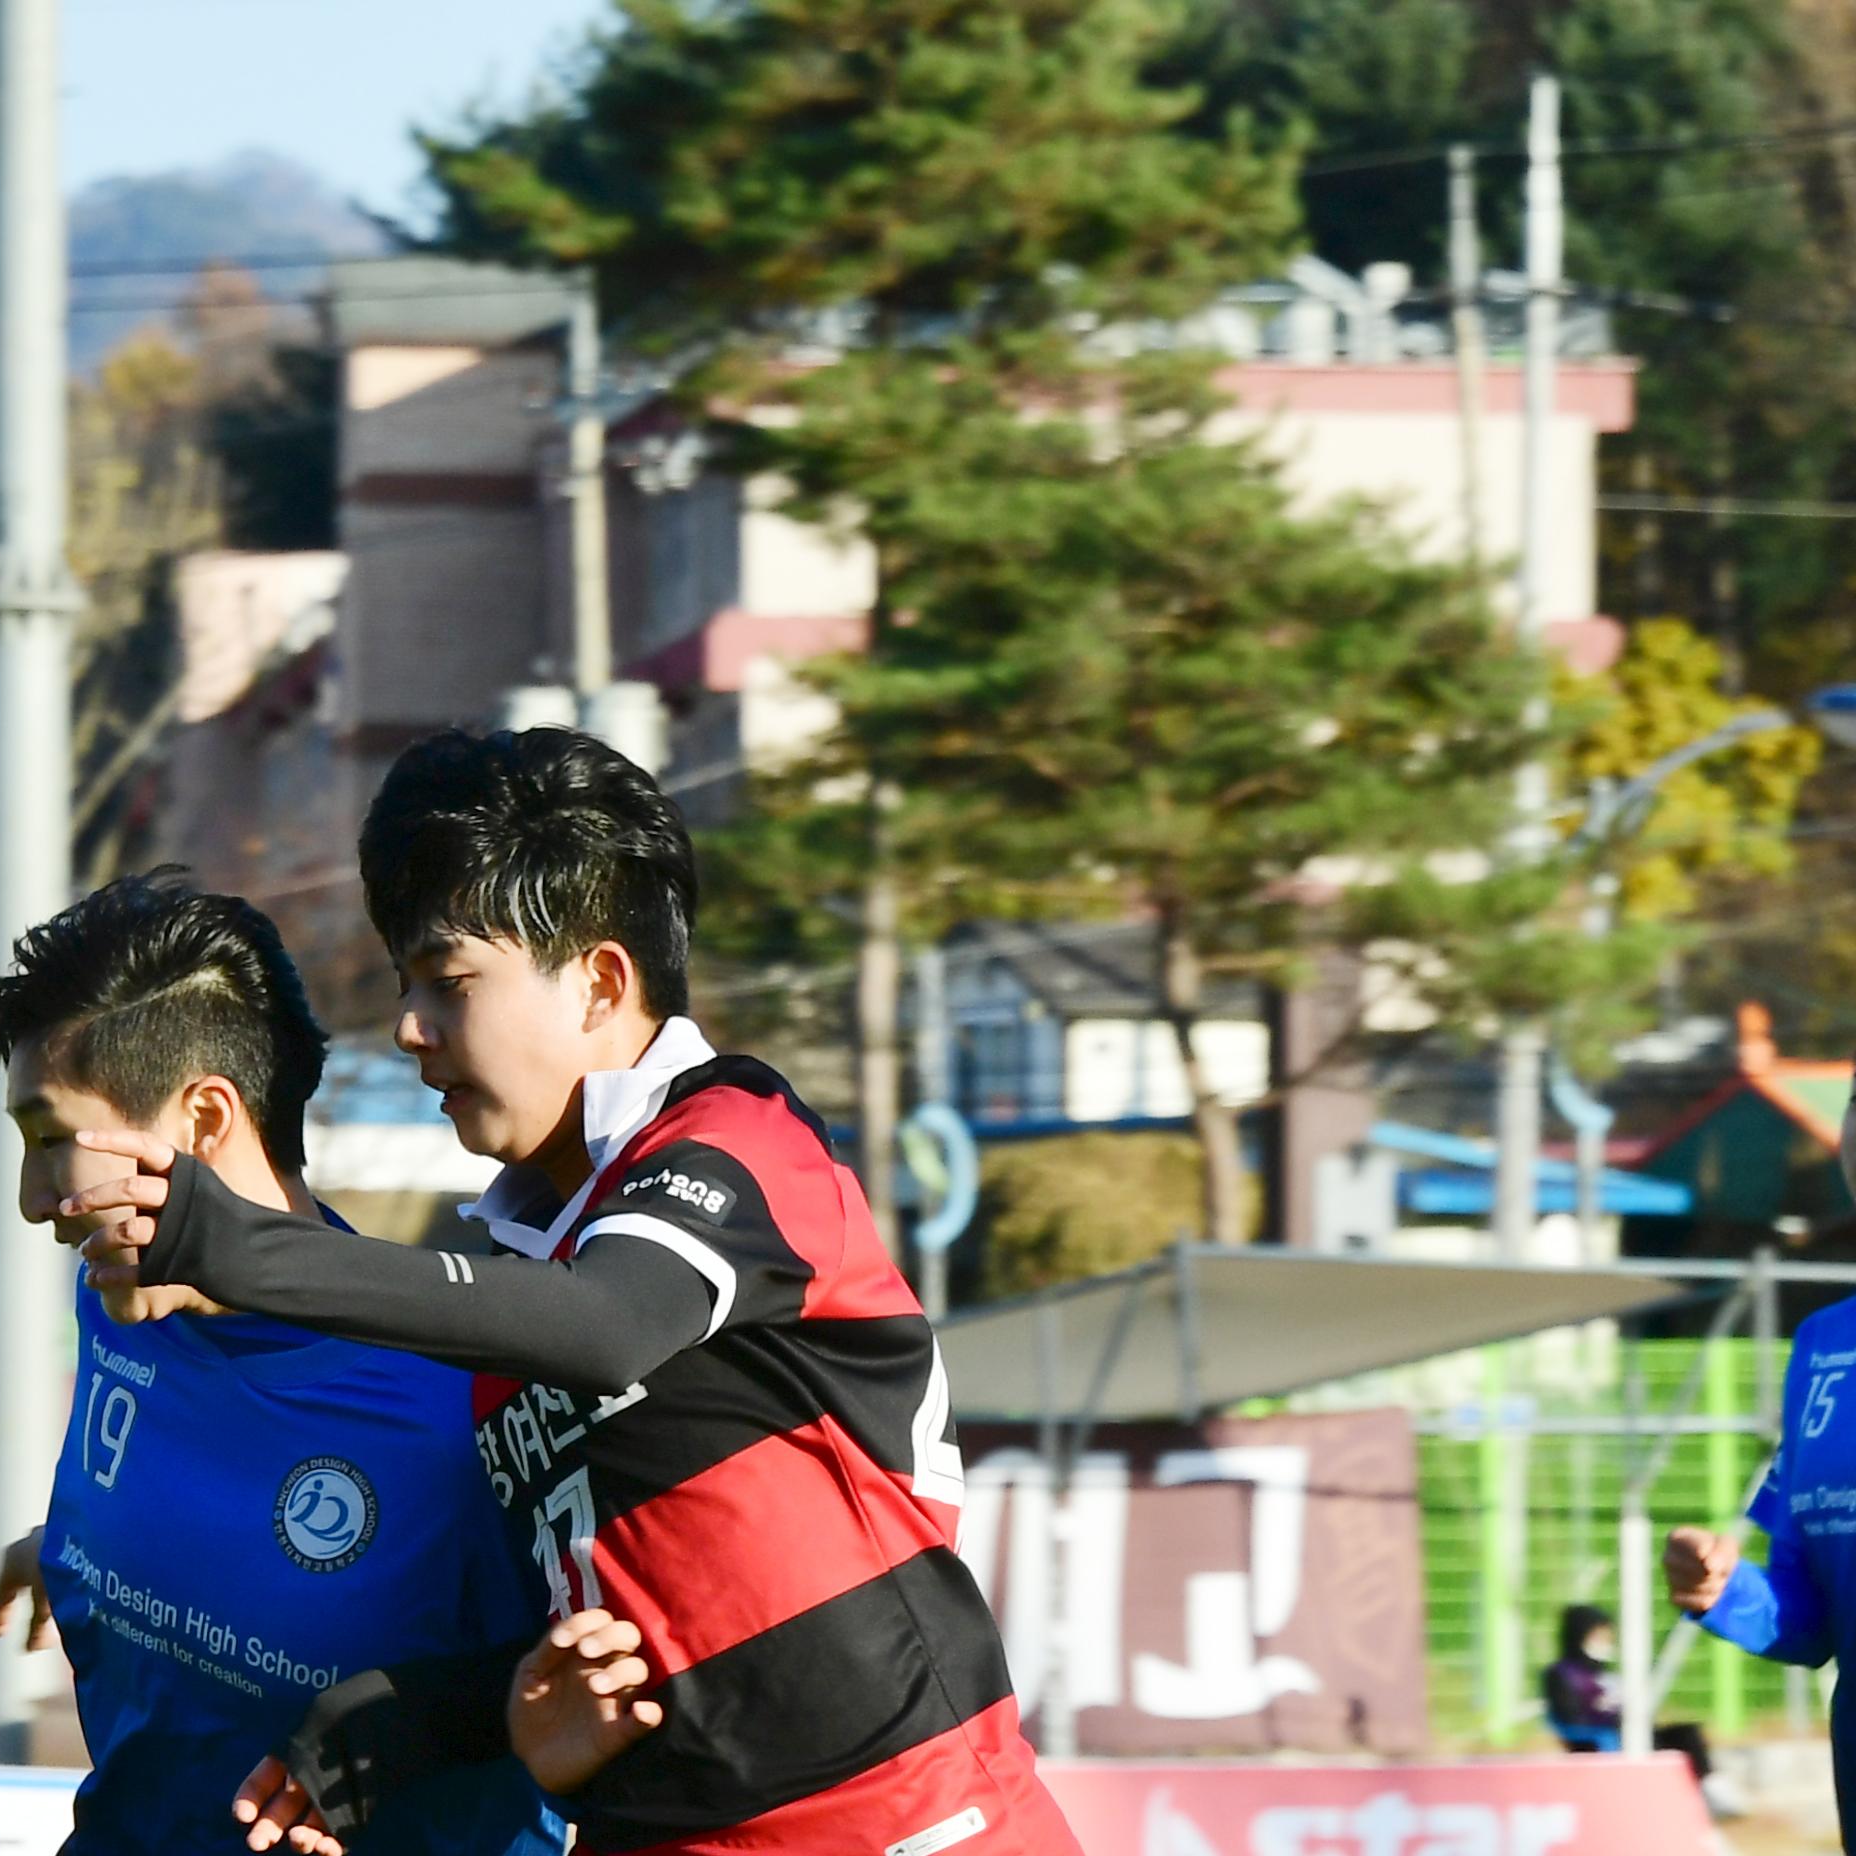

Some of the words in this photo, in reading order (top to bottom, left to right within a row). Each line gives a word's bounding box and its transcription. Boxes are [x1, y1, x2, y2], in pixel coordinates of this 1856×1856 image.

[92, 1334, 156, 1388] hummel
[83, 1371, 137, 1489] 19
[1800, 1372, 1845, 1438] 15
[309, 1458, 349, 1474] DESIGN
[105, 1569, 178, 1629] Design
[185, 1606, 238, 1657] High
[245, 1637, 339, 1691] School
[199, 1655, 263, 1699] creation
